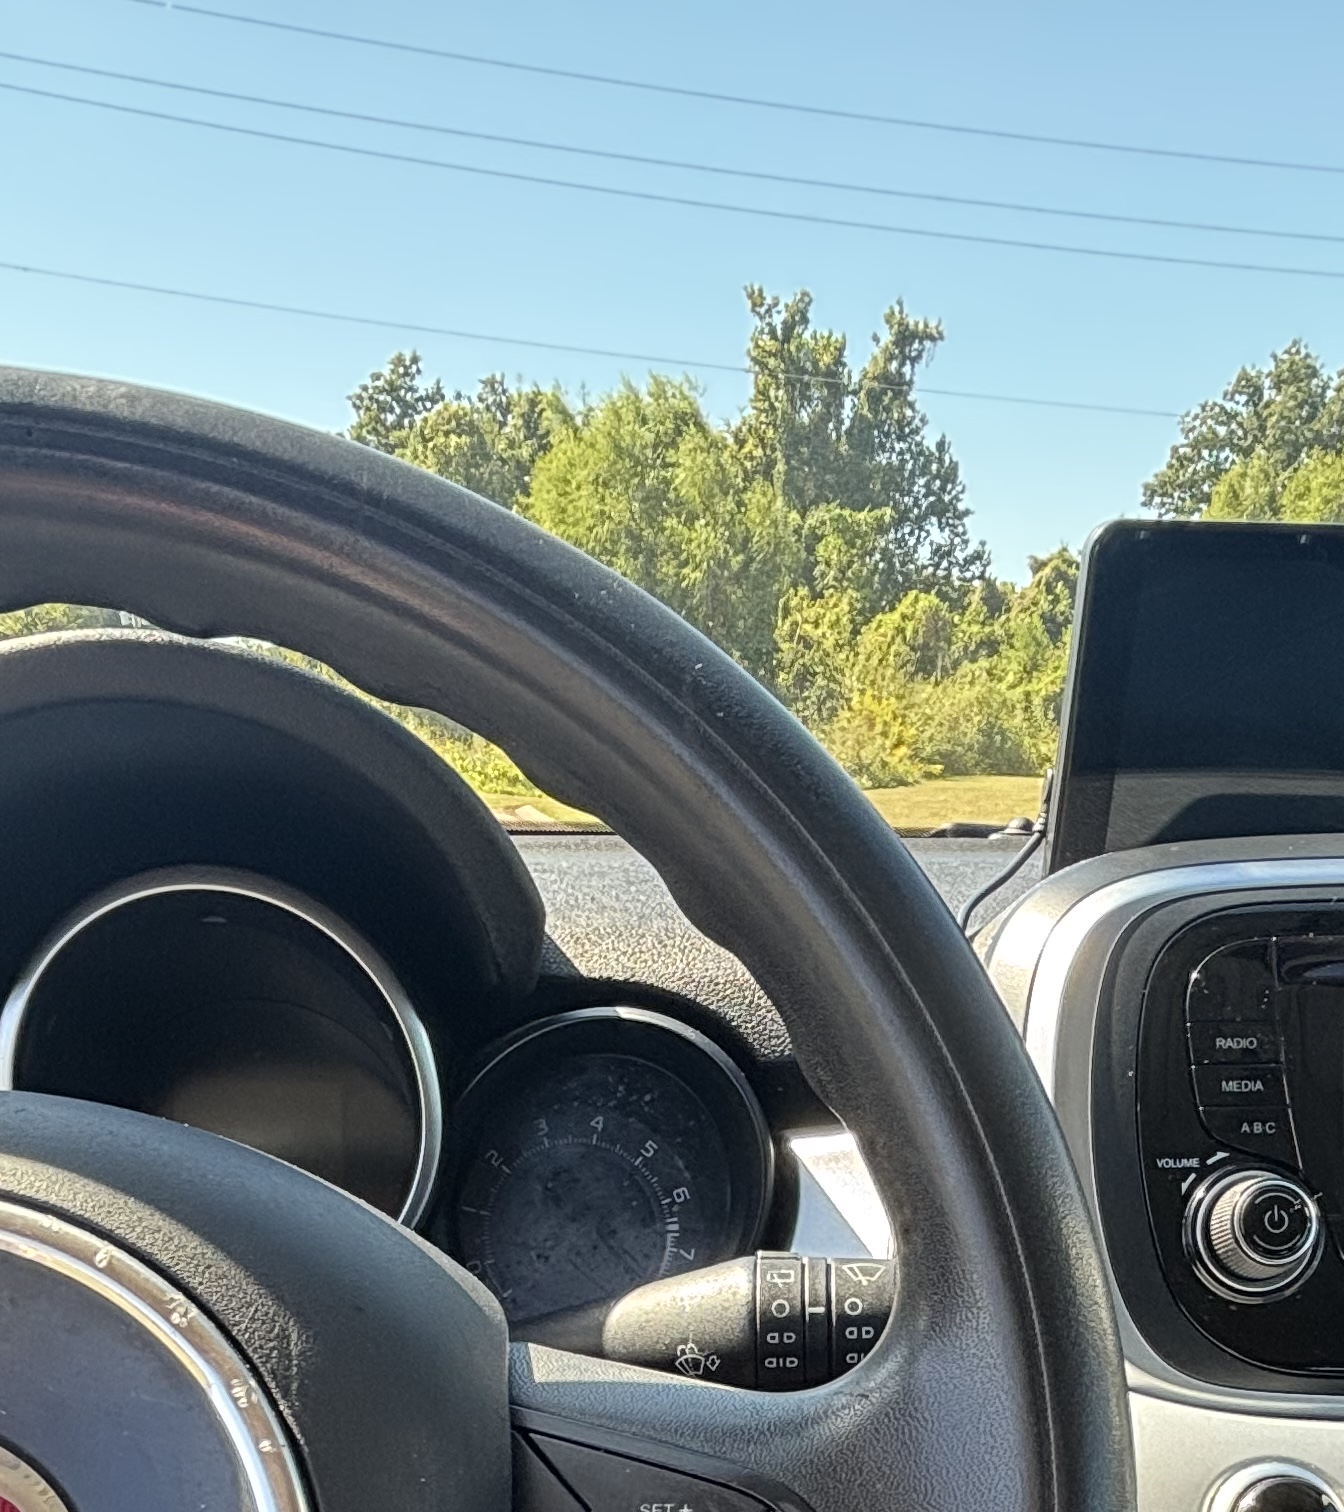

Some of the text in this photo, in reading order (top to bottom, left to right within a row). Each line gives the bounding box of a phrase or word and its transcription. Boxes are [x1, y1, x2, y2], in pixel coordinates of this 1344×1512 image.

[1216, 1037, 1257, 1049] RADIO
[1221, 1080, 1264, 1092] MEDIA
[533, 1118, 549, 1135] 3
[589, 1115, 604, 1132] 4
[639, 1139, 659, 1159] 5
[485, 1150, 504, 1167] 2
[1156, 1157, 1200, 1168] VOLUME
[672, 1186, 691, 1204] 6
[679, 1247, 696, 1261] 7
